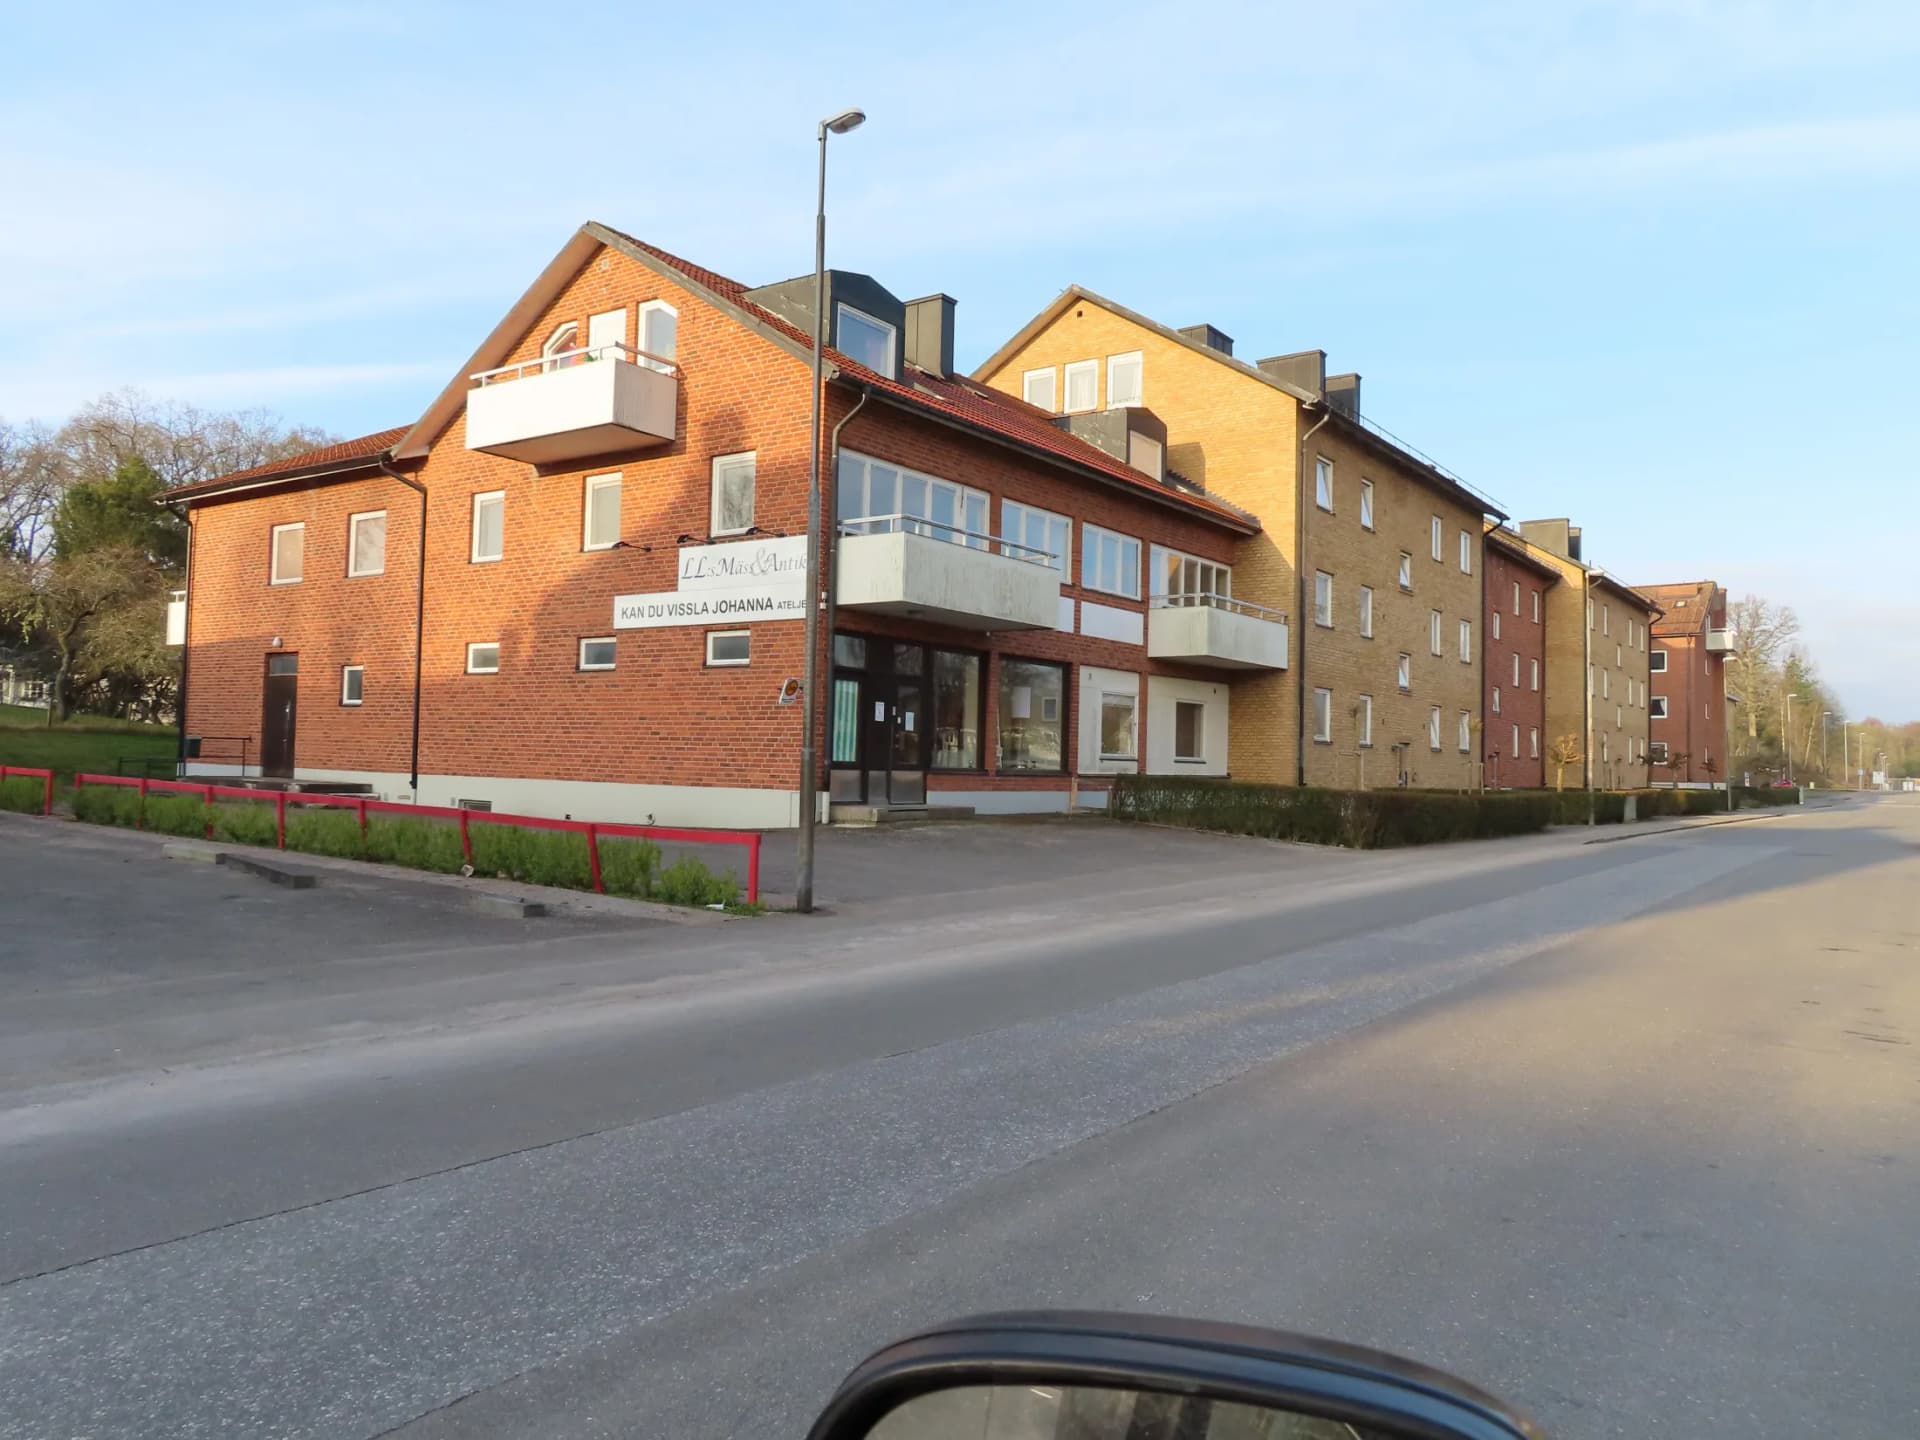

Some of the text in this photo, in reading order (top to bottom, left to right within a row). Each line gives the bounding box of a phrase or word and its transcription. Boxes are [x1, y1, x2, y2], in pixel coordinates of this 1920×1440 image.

[750, 546, 771, 577] &
[621, 607, 645, 620] KAN
[648, 604, 664, 618] DU
[667, 601, 709, 616] VISSLA
[712, 596, 774, 614] JOHANNA
